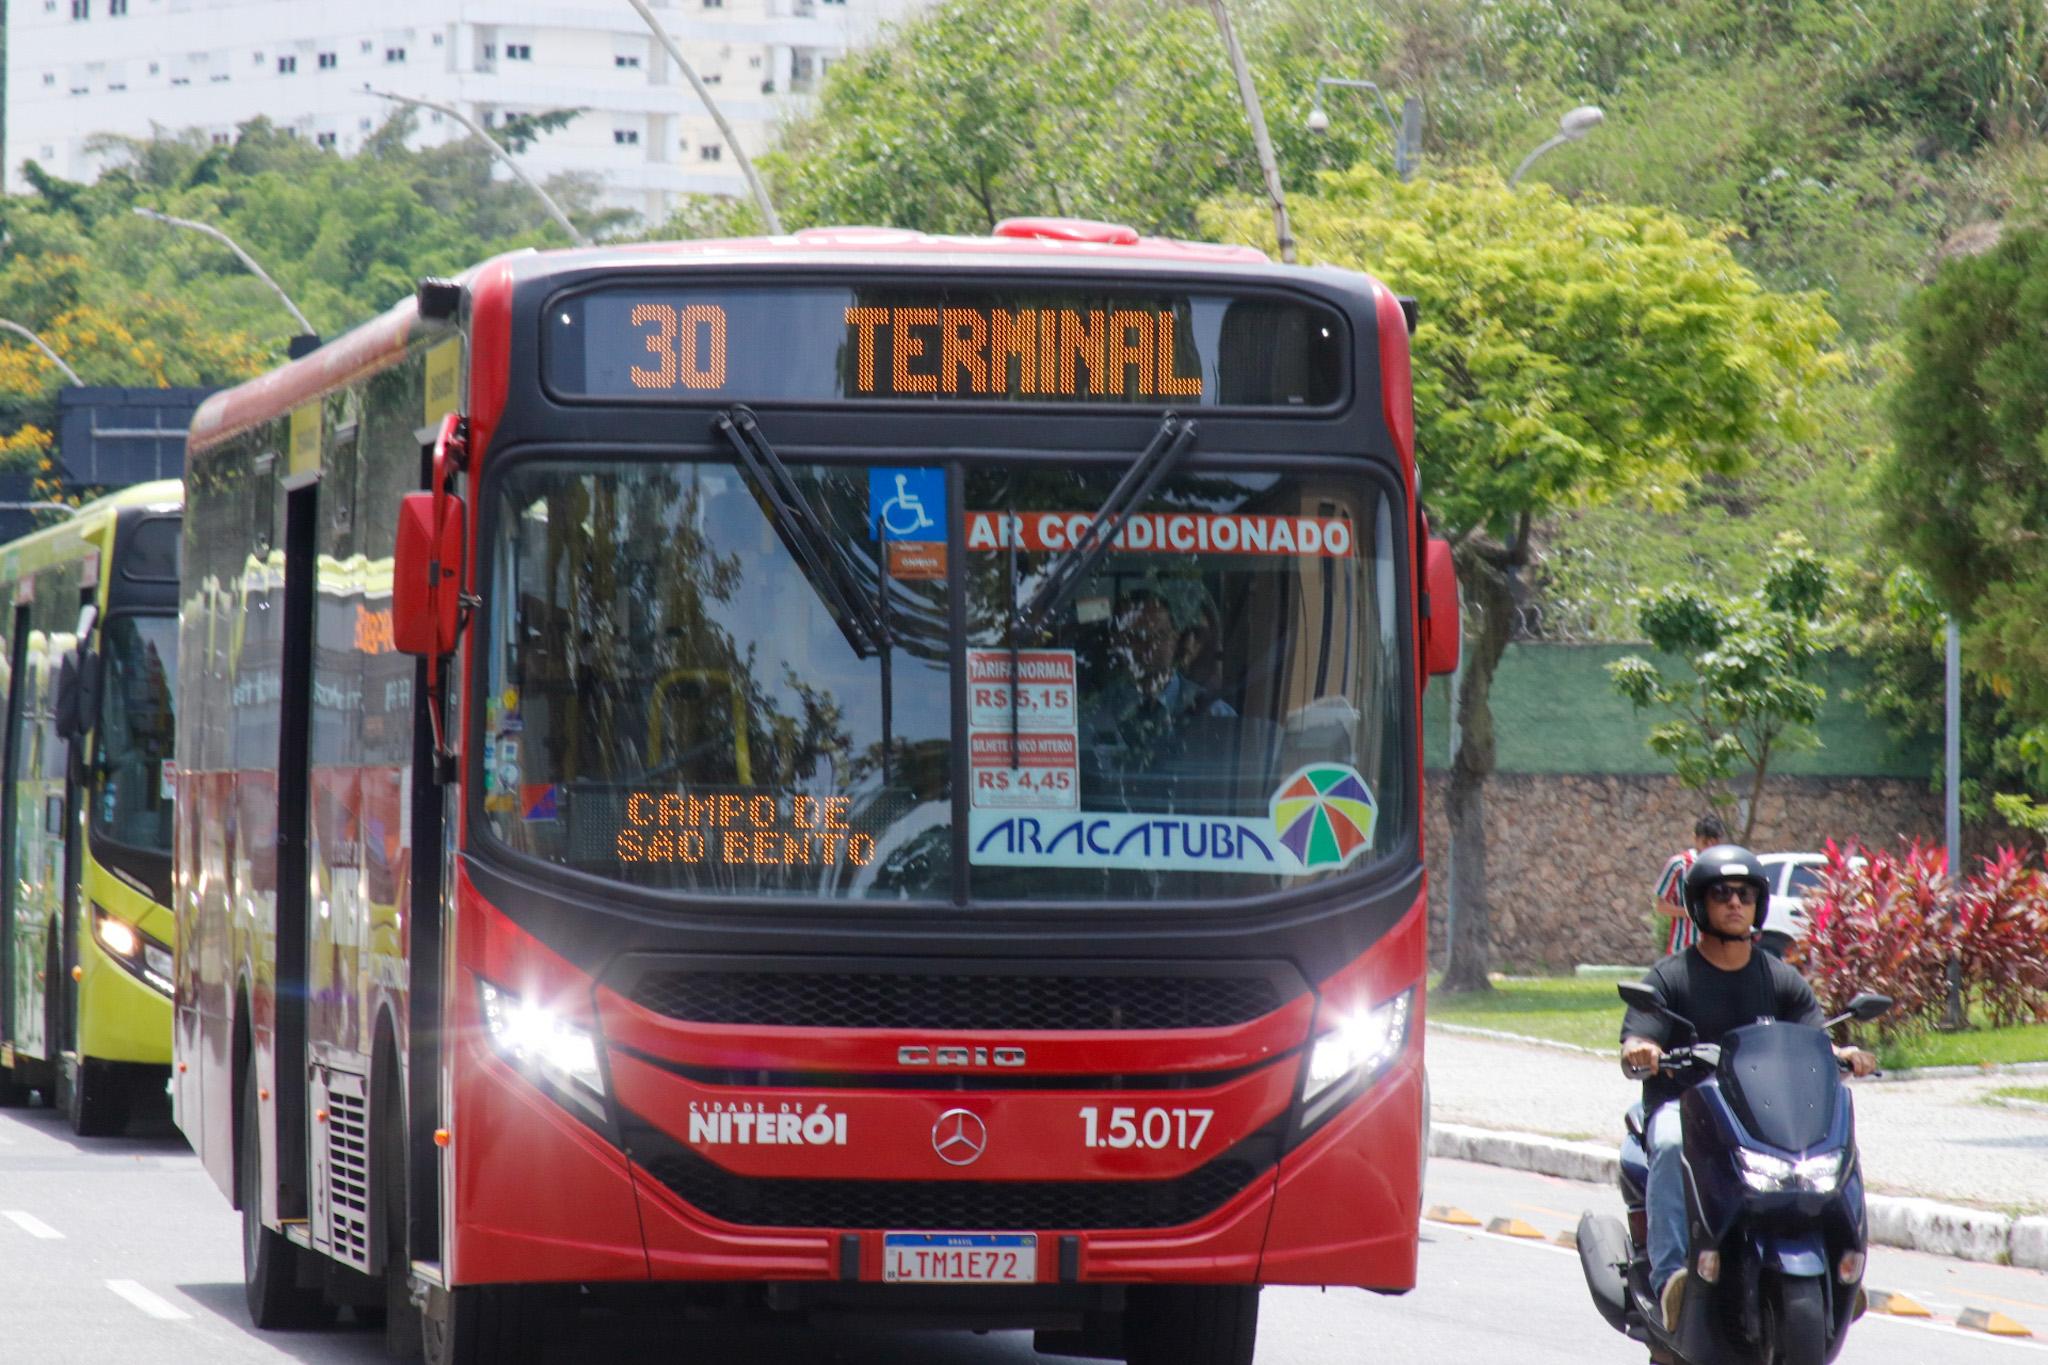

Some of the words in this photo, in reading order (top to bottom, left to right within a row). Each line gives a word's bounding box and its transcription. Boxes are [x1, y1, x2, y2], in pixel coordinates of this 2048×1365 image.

[631, 303, 727, 390] 30
[844, 306, 1203, 396] TERMINAL
[968, 514, 1025, 549] AR
[1018, 661, 1072, 680] NORMAL
[1015, 688, 1069, 712] 5,15
[1018, 771, 1069, 793] 4,45
[628, 793, 776, 828] CAMPO
[794, 795, 850, 829] DE
[723, 831, 876, 866] BENTO
[897, 1045, 1026, 1067] CAIO
[689, 1101, 765, 1113] CIDADE
[781, 1102, 803, 1114] DE
[689, 1104, 848, 1146] NITERÓI
[1079, 1106, 1215, 1151] 1.5.017
[897, 1250, 1018, 1279] LTM1E72
